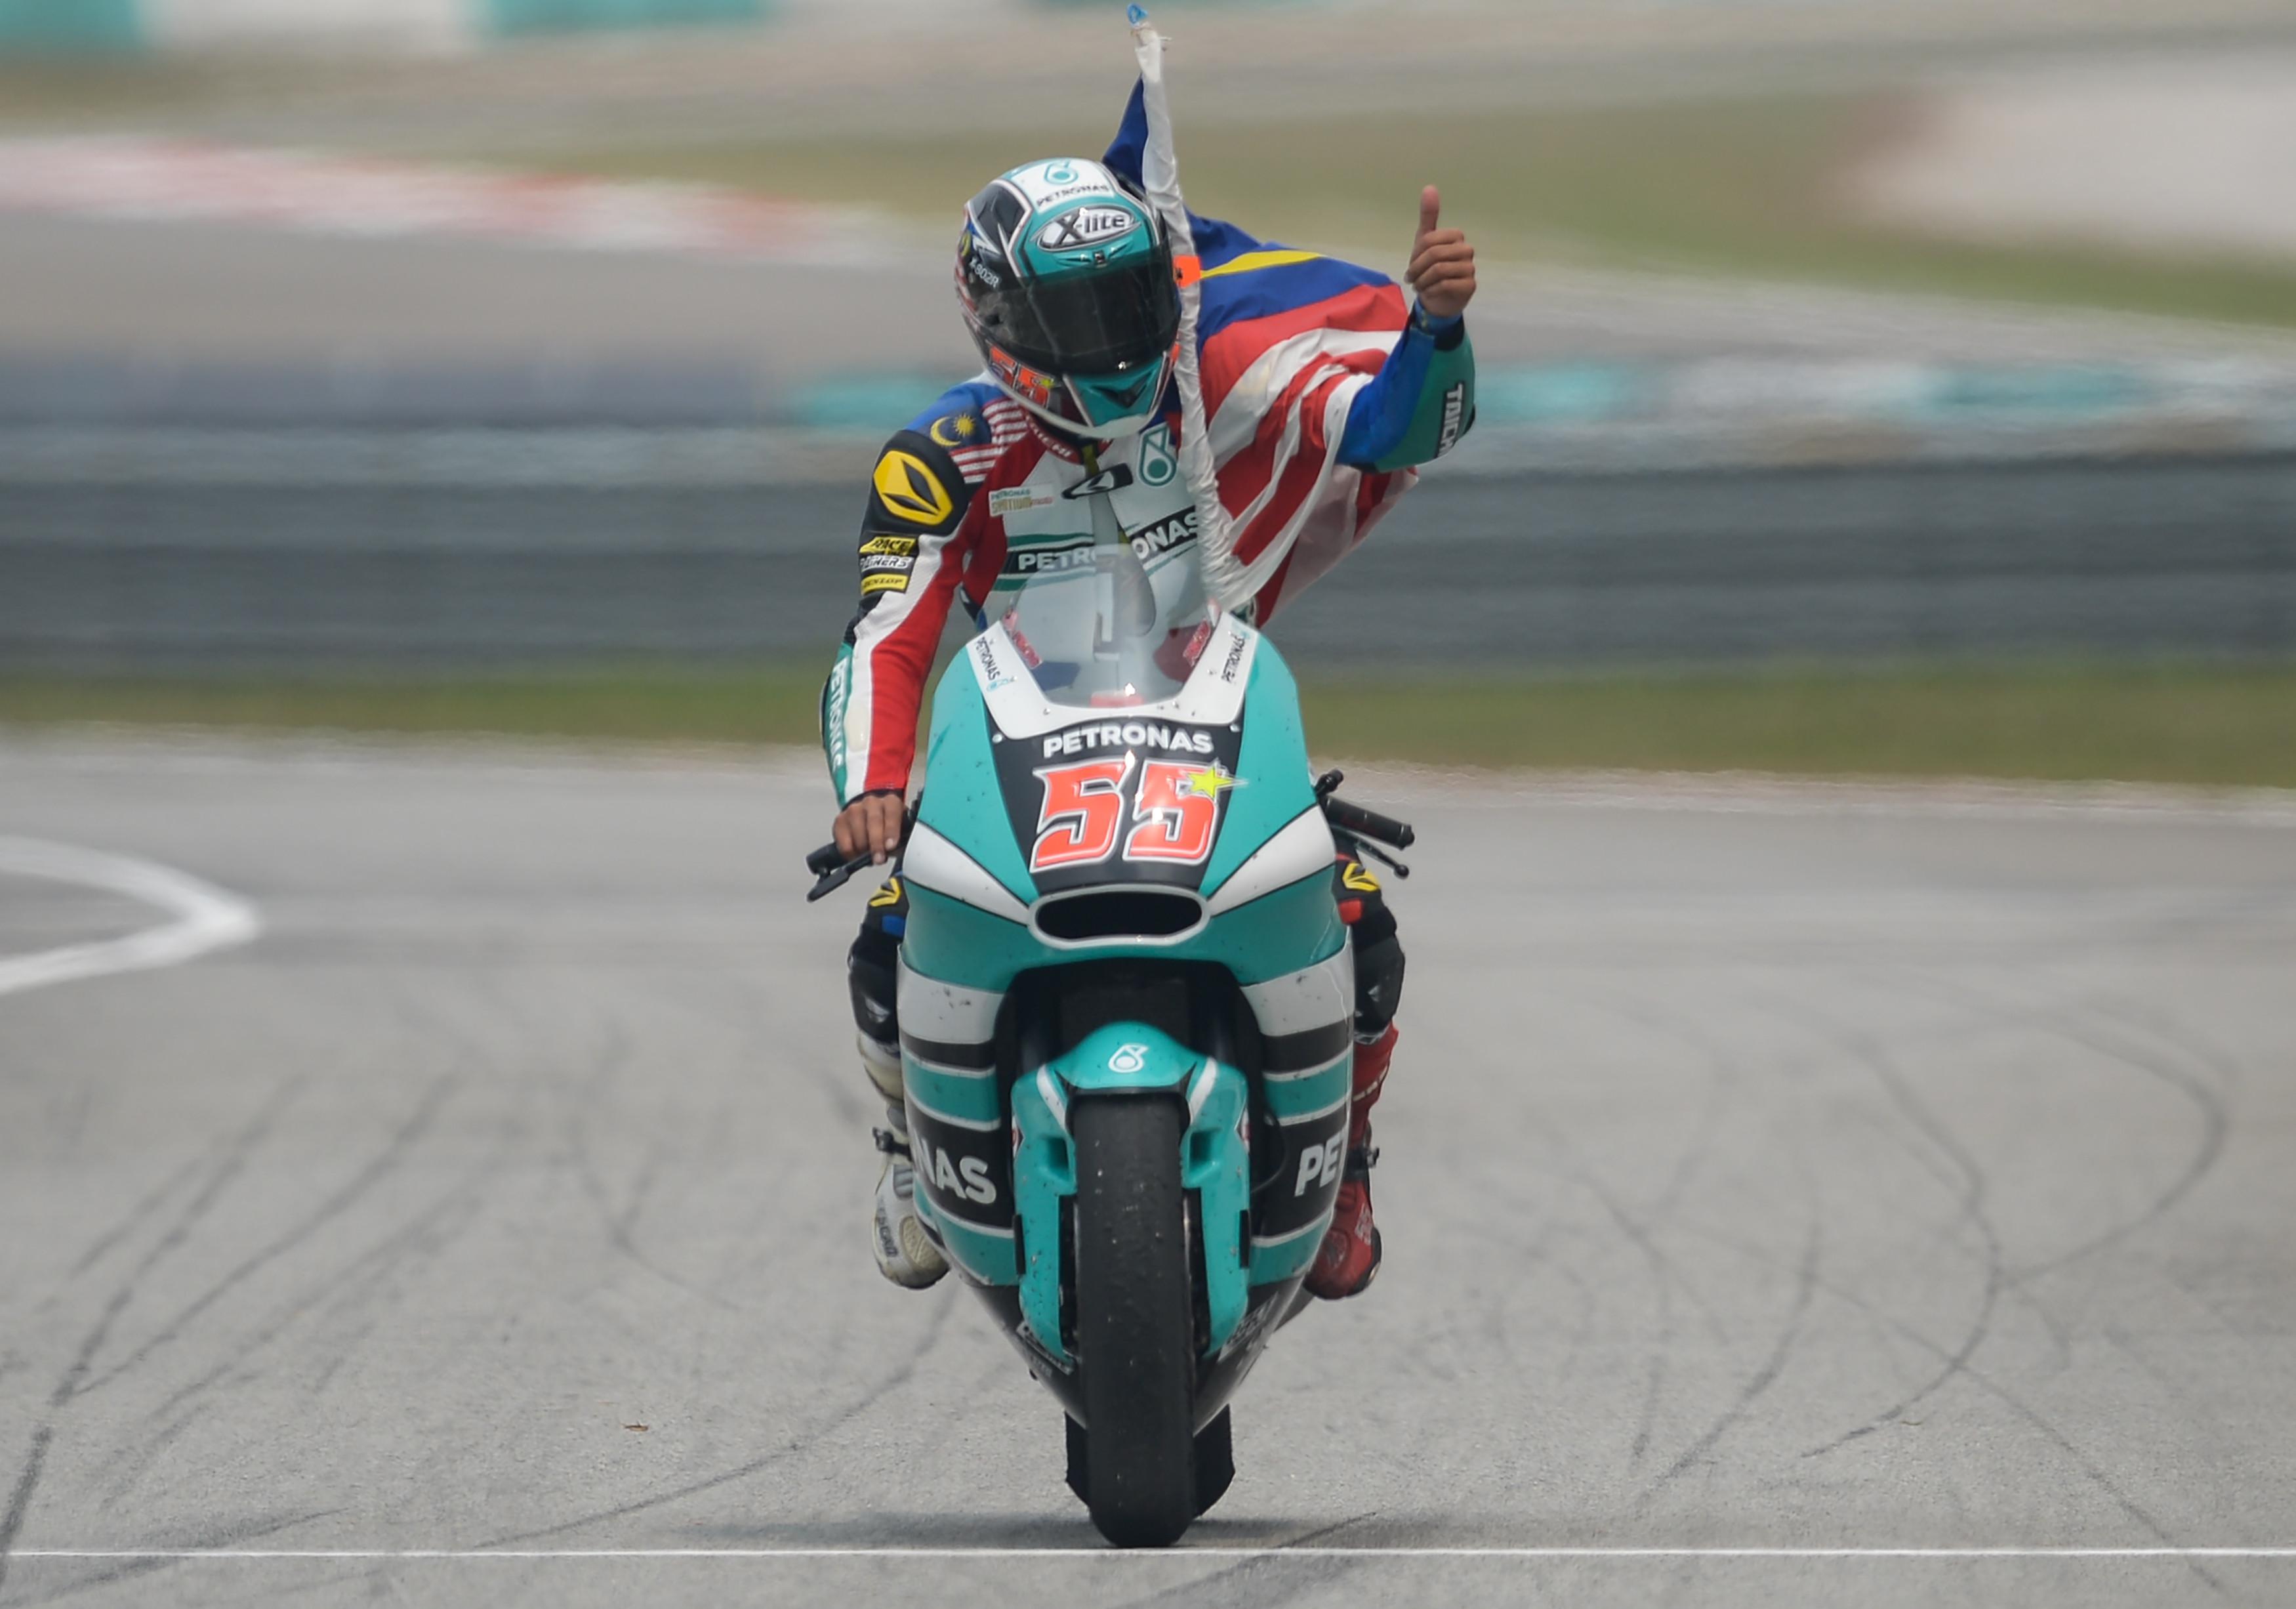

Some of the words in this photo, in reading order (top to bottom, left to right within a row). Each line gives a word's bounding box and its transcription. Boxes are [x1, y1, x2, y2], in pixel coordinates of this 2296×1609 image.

[1052, 207, 1126, 248] X-lite
[975, 636, 1000, 681] PETRONAS
[1221, 635, 1246, 683] PETRONAS
[829, 656, 850, 773] PETRONAS
[1043, 722, 1214, 759] PETRONAS
[1029, 757, 1220, 873] 55
